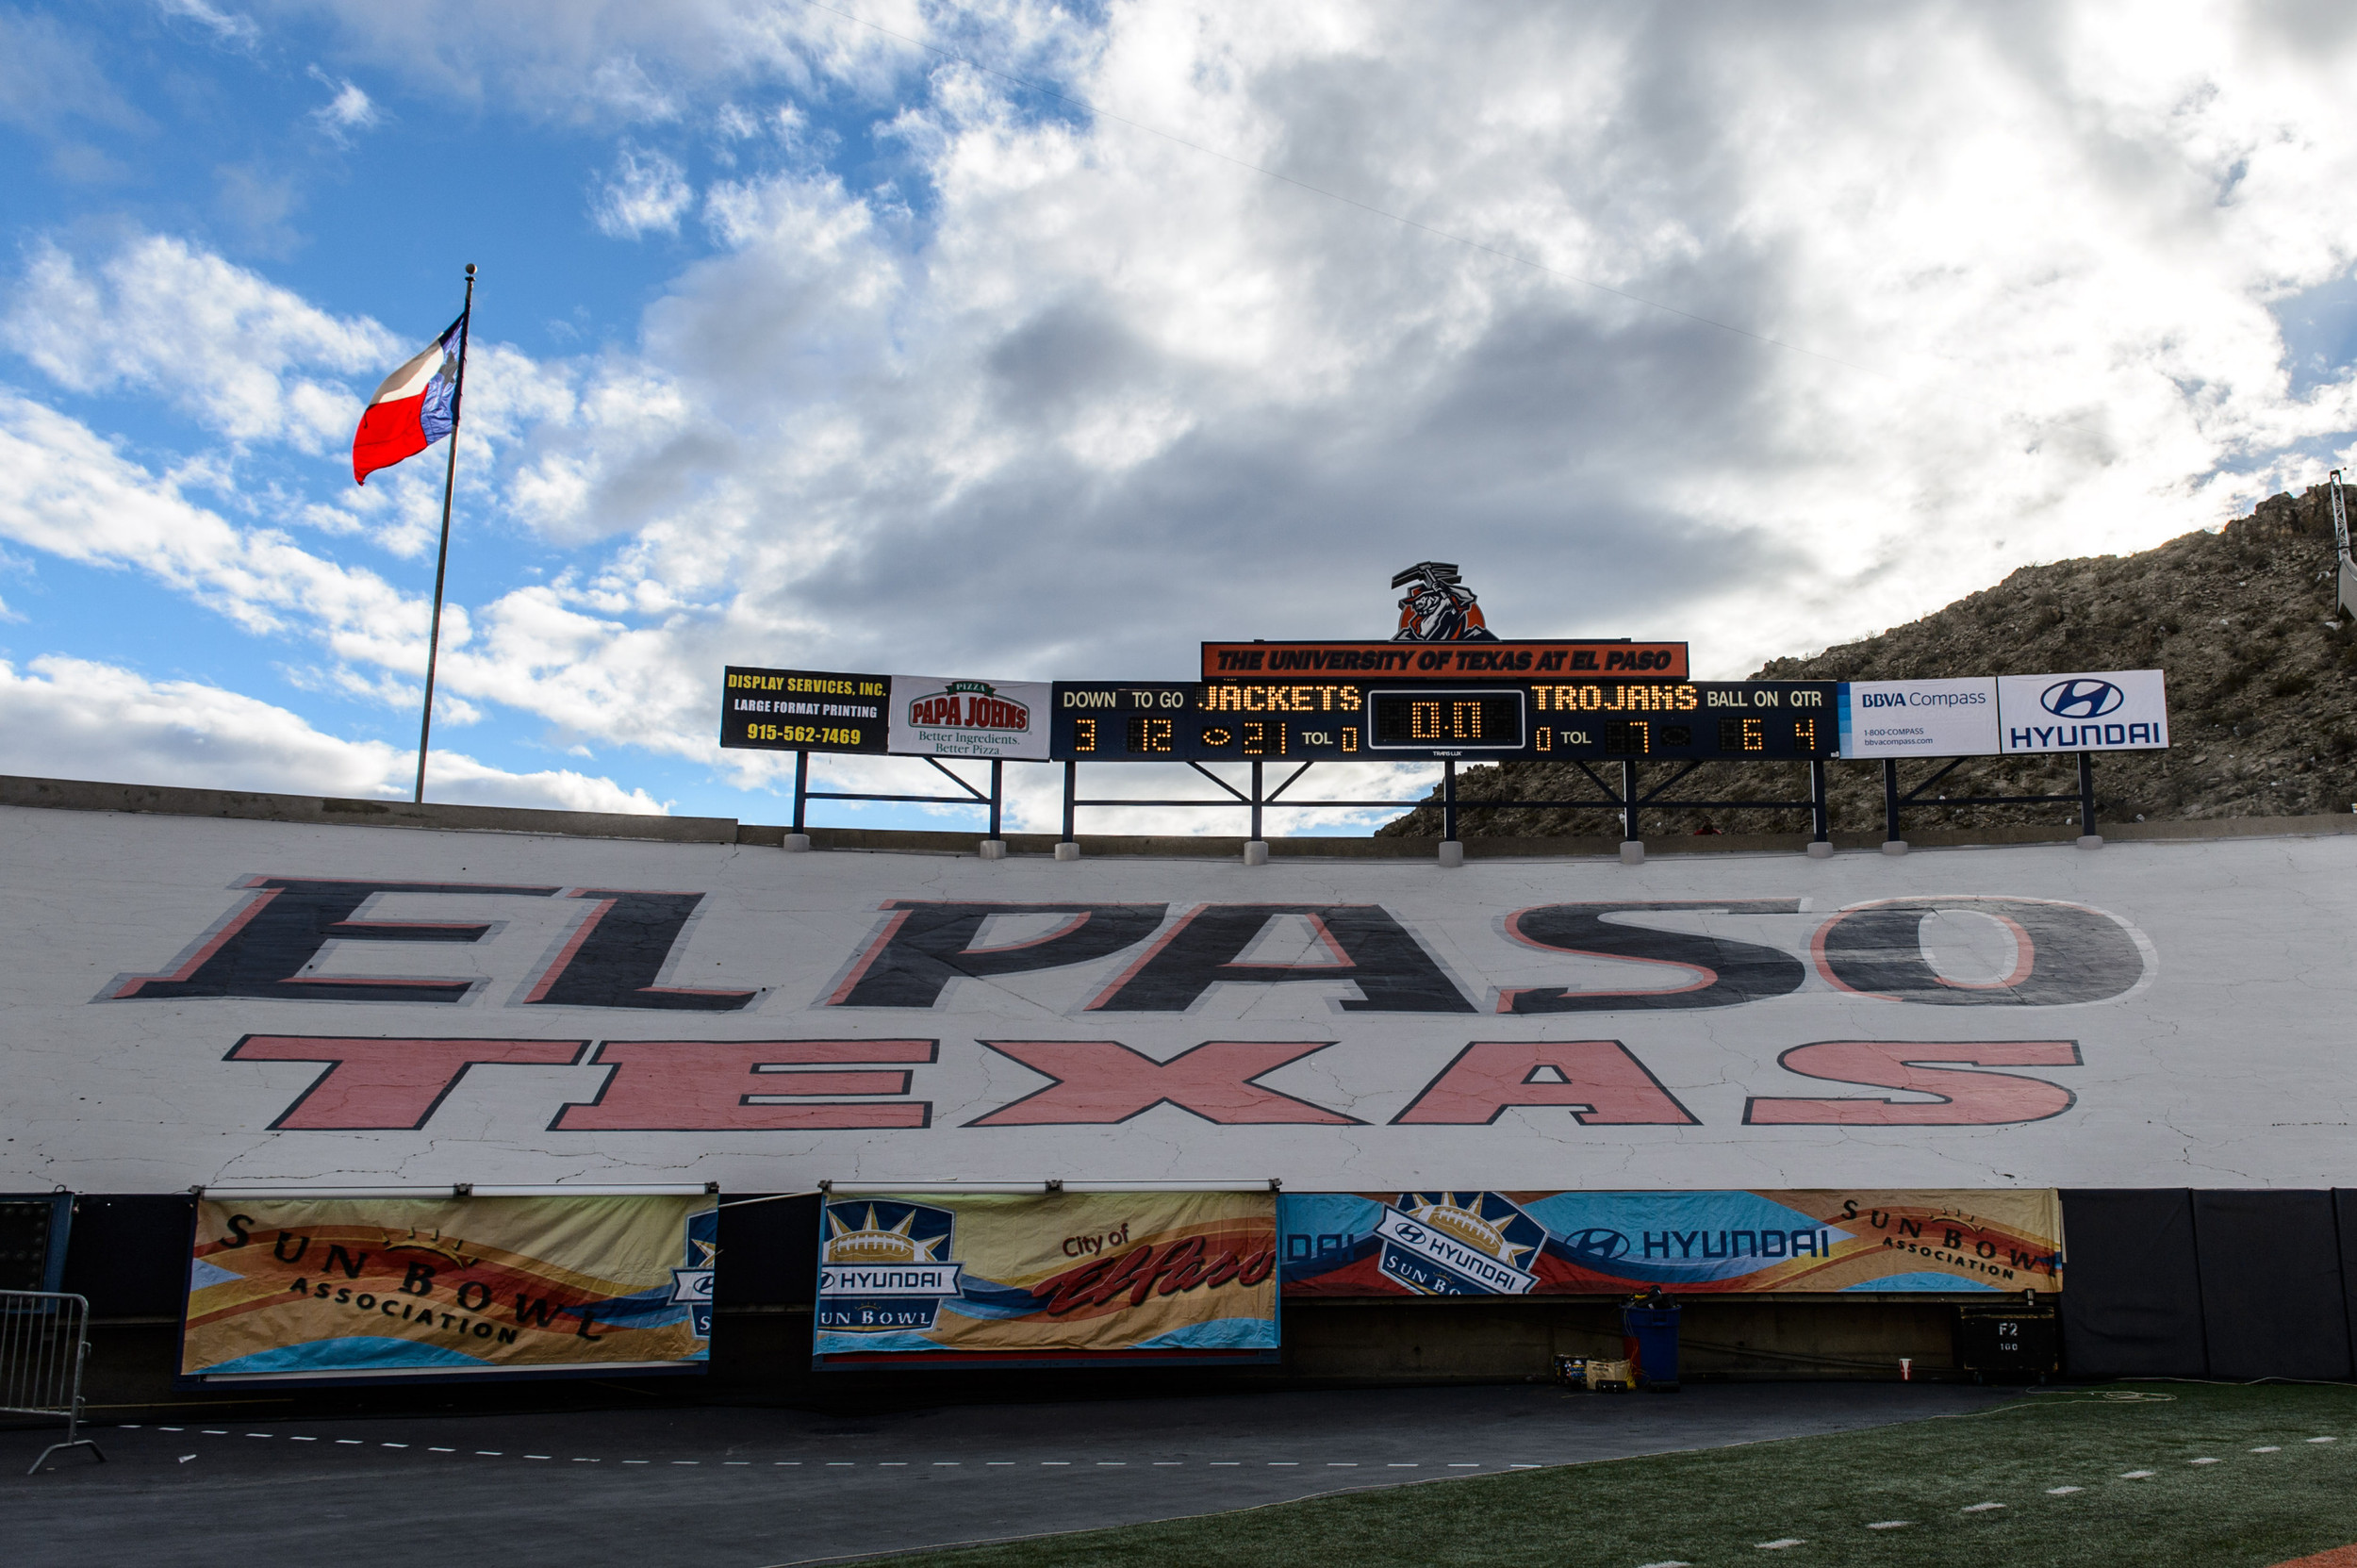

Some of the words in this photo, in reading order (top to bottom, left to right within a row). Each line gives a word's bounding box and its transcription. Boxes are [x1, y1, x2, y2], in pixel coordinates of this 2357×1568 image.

[1217, 651, 1265, 670] THE
[1267, 651, 1418, 670] UNIVERSITY
[1417, 651, 1455, 670] OF
[1456, 651, 1532, 670] TEXAS
[1534, 651, 1569, 670] AT
[1569, 651, 1600, 670] EL
[1605, 651, 1672, 670] PASO
[728, 673, 783, 691] DISPLAY
[787, 677, 856, 696] SERVICES,
[860, 682, 886, 697] INC.
[956, 683, 986, 692] PIZZA
[1531, 685, 1698, 710] TROJANS
[734, 699, 771, 713] LARGE
[773, 701, 820, 716] FORMAT
[822, 702, 878, 718] PRINTING
[912, 696, 962, 725] PAPA
[1063, 691, 1116, 708] DOWN
[1132, 691, 1153, 708] TO
[1160, 691, 1184, 708] GO
[1197, 685, 1362, 711] JACKETS
[1707, 690, 1748, 707] BALL
[1754, 690, 1778, 707] ON
[1790, 690, 1821, 708] QTR
[1862, 693, 1906, 707] BBVA
[1909, 692, 1986, 707] Compass
[747, 722, 861, 745] 915-562-7469
[919, 731, 952, 742] Better
[956, 733, 1020, 745] Ingredients.
[1076, 718, 1096, 751] 3
[1143, 718, 1172, 752] 12
[1244, 722, 1287, 754] 21
[1302, 732, 1333, 745] TOL
[1342, 726, 1358, 752] 0
[1536, 726, 1551, 751] 0
[1560, 732, 1591, 745] TOL
[1629, 721, 1649, 754] 7
[1743, 718, 1762, 751] 6
[1795, 718, 1815, 751] 4
[1864, 728, 1924, 736] 1-800-COMPASS
[1865, 737, 1933, 746] bbvacompass.com
[2010, 722, 2160, 749] HYUNDAI
[935, 743, 969, 753] Better
[973, 745, 1002, 755] Pizza.
[89, 872, 775, 1013] EL
[807, 893, 2159, 1016] PASO
[222, 1033, 2084, 1131] TEXAS
[1840, 1198, 1922, 1239] SUN
[1063, 1235, 1102, 1257] City
[1108, 1222, 1129, 1246] of
[1288, 1234, 1354, 1262] DAI
[1643, 1230, 1829, 1259] HYUNDAI
[1429, 1238, 1516, 1290] HYUNDAI
[1881, 1237, 2014, 1280] ASSOCIATION
[218, 1213, 368, 1279] SUN
[398, 1261, 607, 1342] BOWL
[841, 1272, 942, 1288] HYUNDAI
[1386, 1255, 1428, 1284] SUN
[1433, 1278, 1461, 1296] BO
[290, 1277, 519, 1345] ASSOCIATION
[820, 1312, 850, 1325] UN
[862, 1311, 931, 1325] BOWL
[1999, 1322, 2019, 1337] F2
